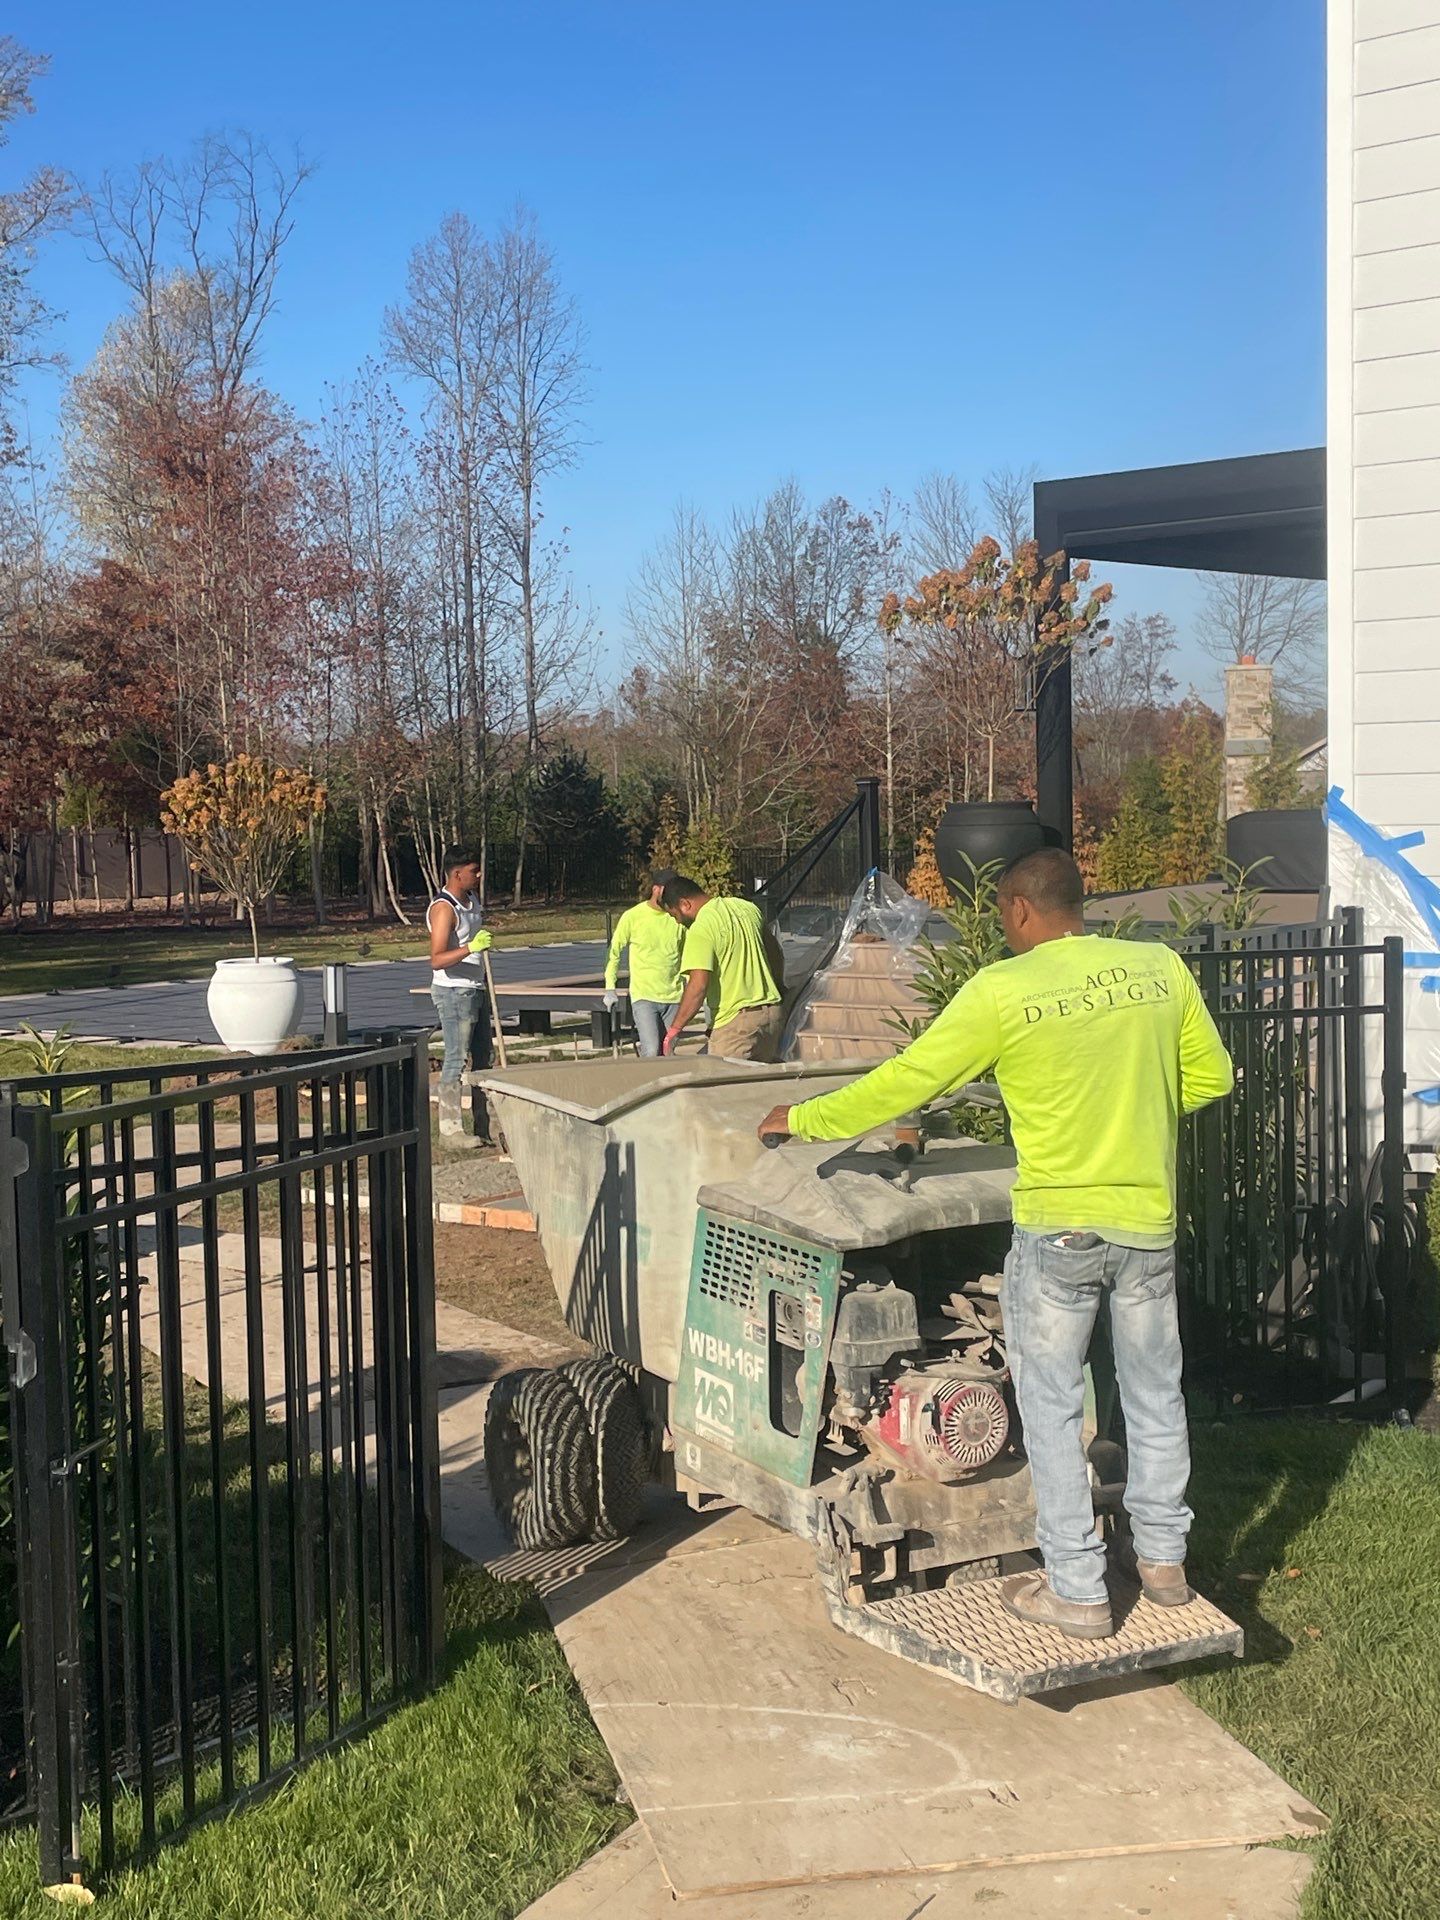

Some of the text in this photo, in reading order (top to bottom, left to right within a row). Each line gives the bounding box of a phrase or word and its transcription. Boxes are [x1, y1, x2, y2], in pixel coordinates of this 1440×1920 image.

[1086, 967, 1128, 991] ACD
[1024, 980, 1170, 1024] DESIGN
[688, 1327, 765, 1383] WBH-16F
